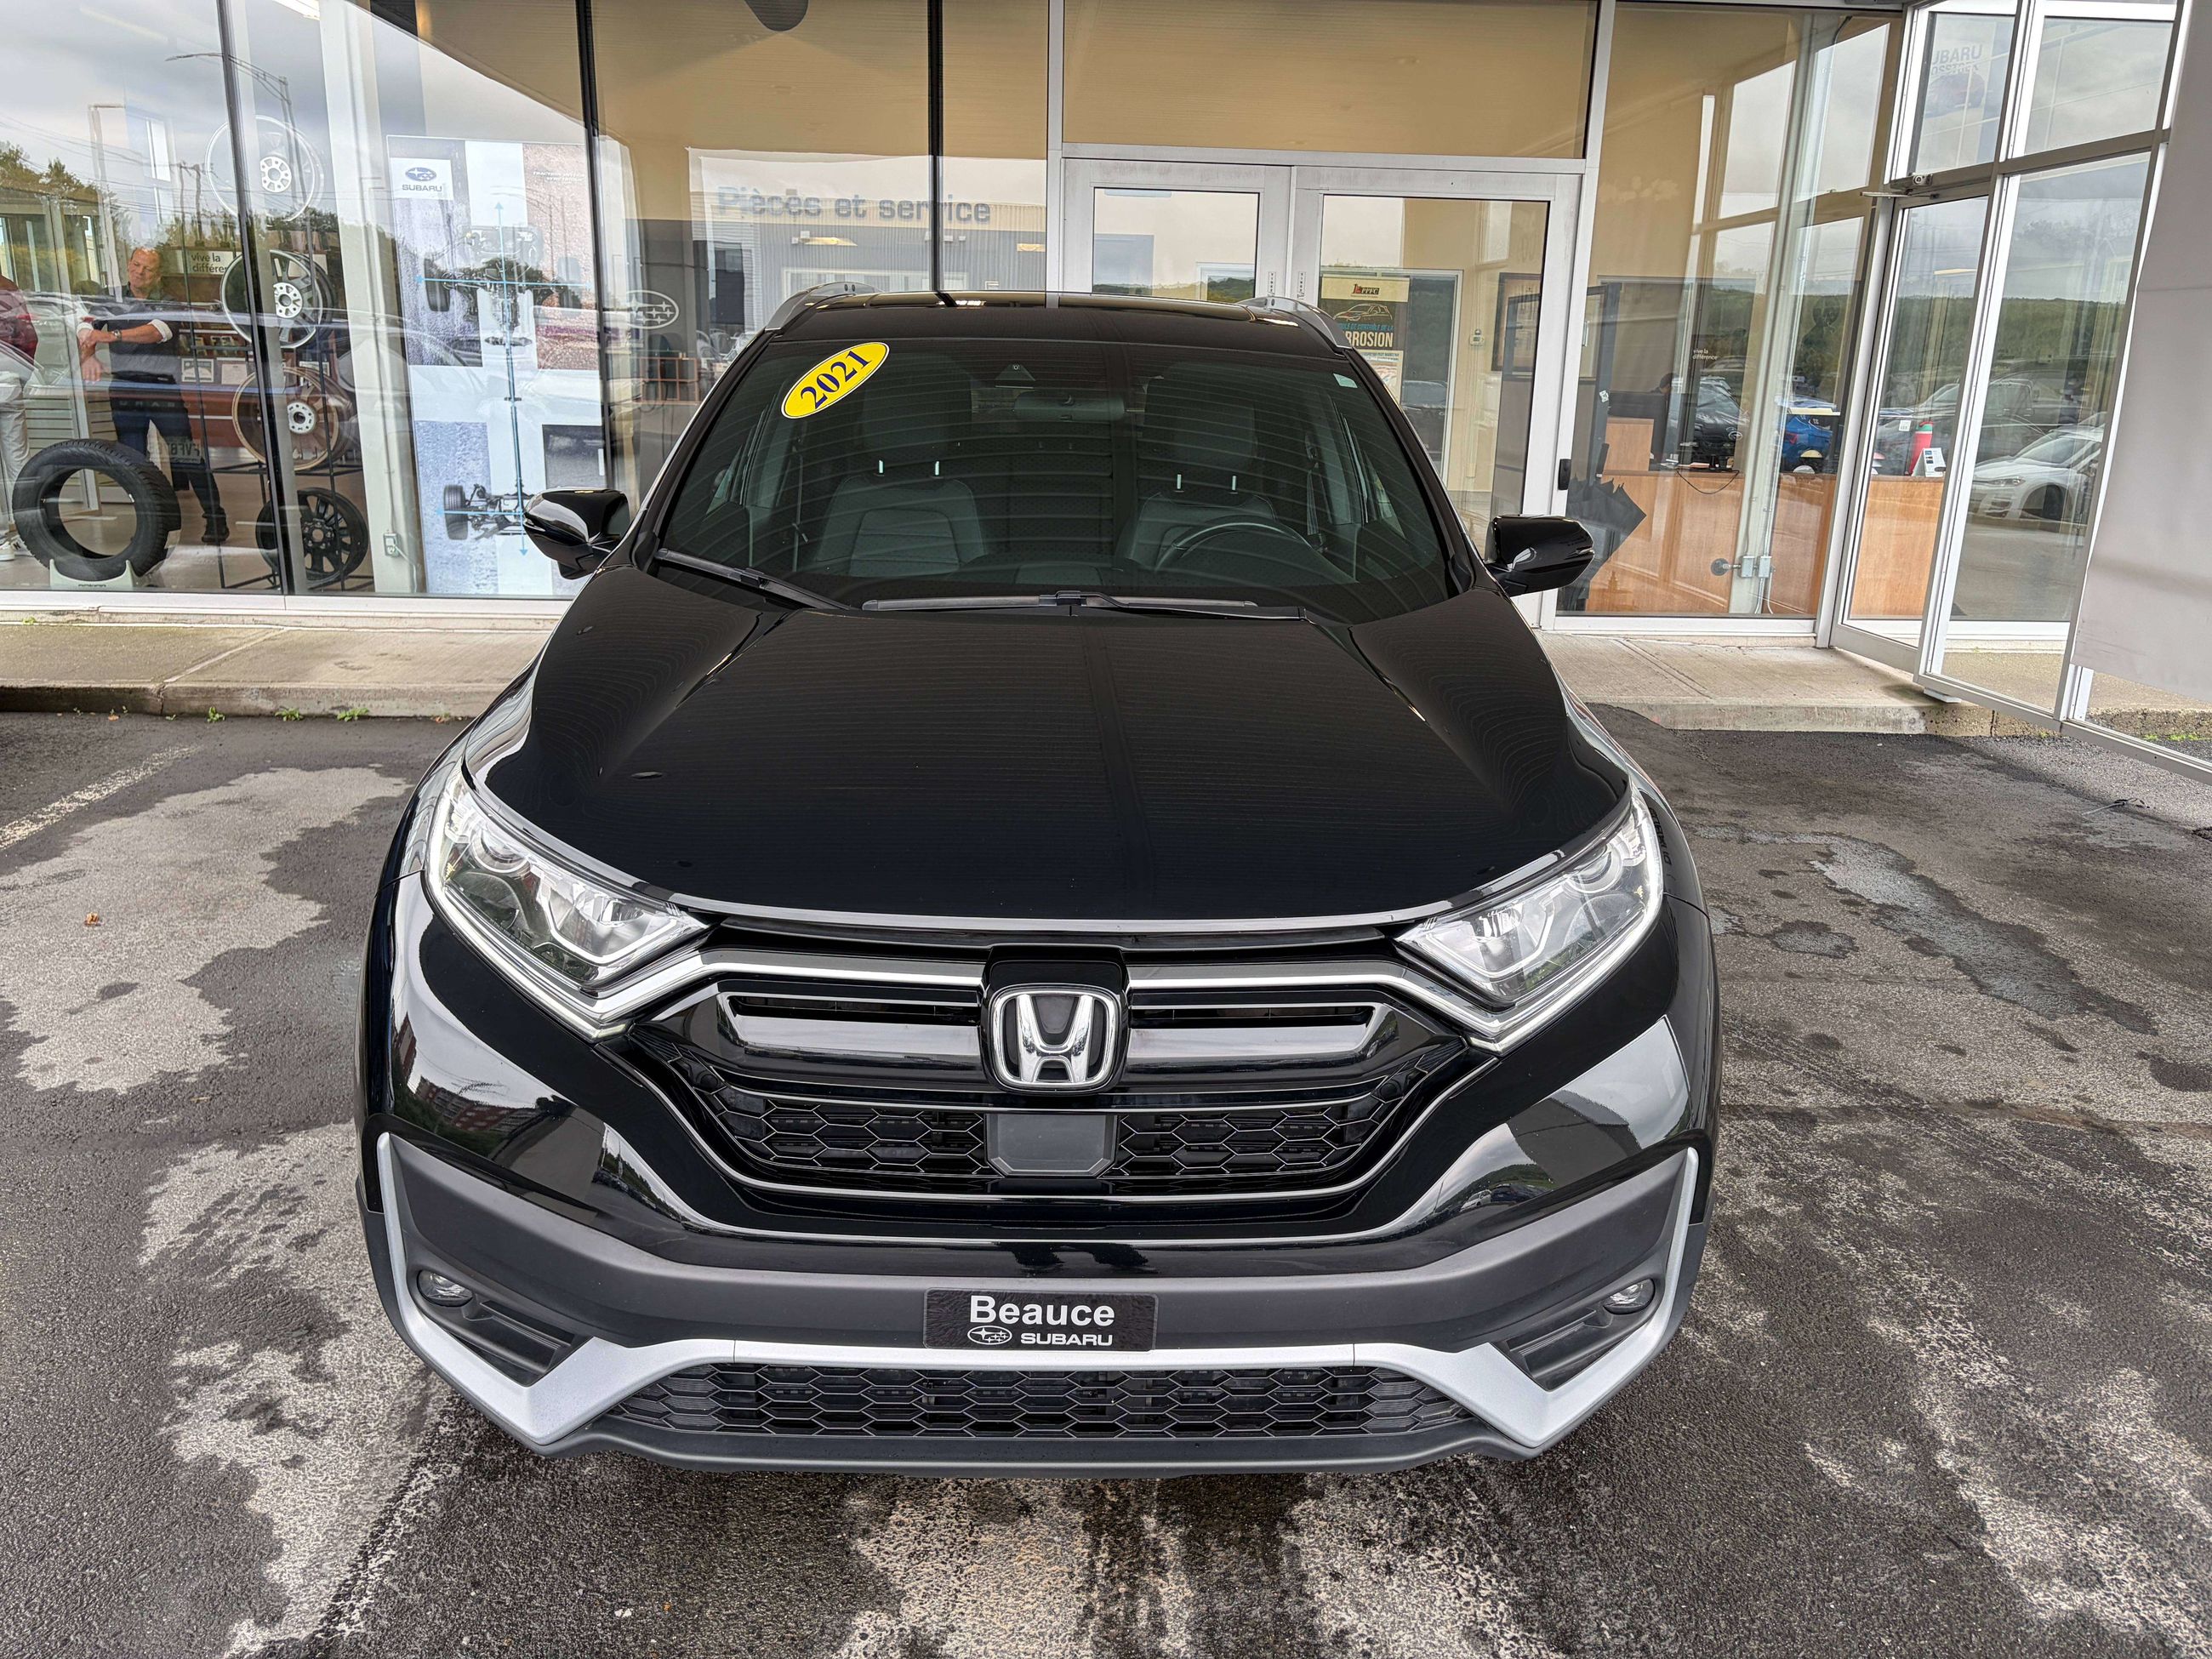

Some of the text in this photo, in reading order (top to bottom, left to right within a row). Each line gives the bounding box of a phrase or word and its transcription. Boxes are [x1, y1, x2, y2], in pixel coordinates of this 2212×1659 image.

[402, 184, 442, 192] SUBARU
[835, 194, 867, 219] et
[191, 252, 220, 262] vive la
[801, 351, 872, 410] 2021
[970, 1295, 1115, 1326] Beauce
[1020, 1332, 1114, 1347] SUBARU
